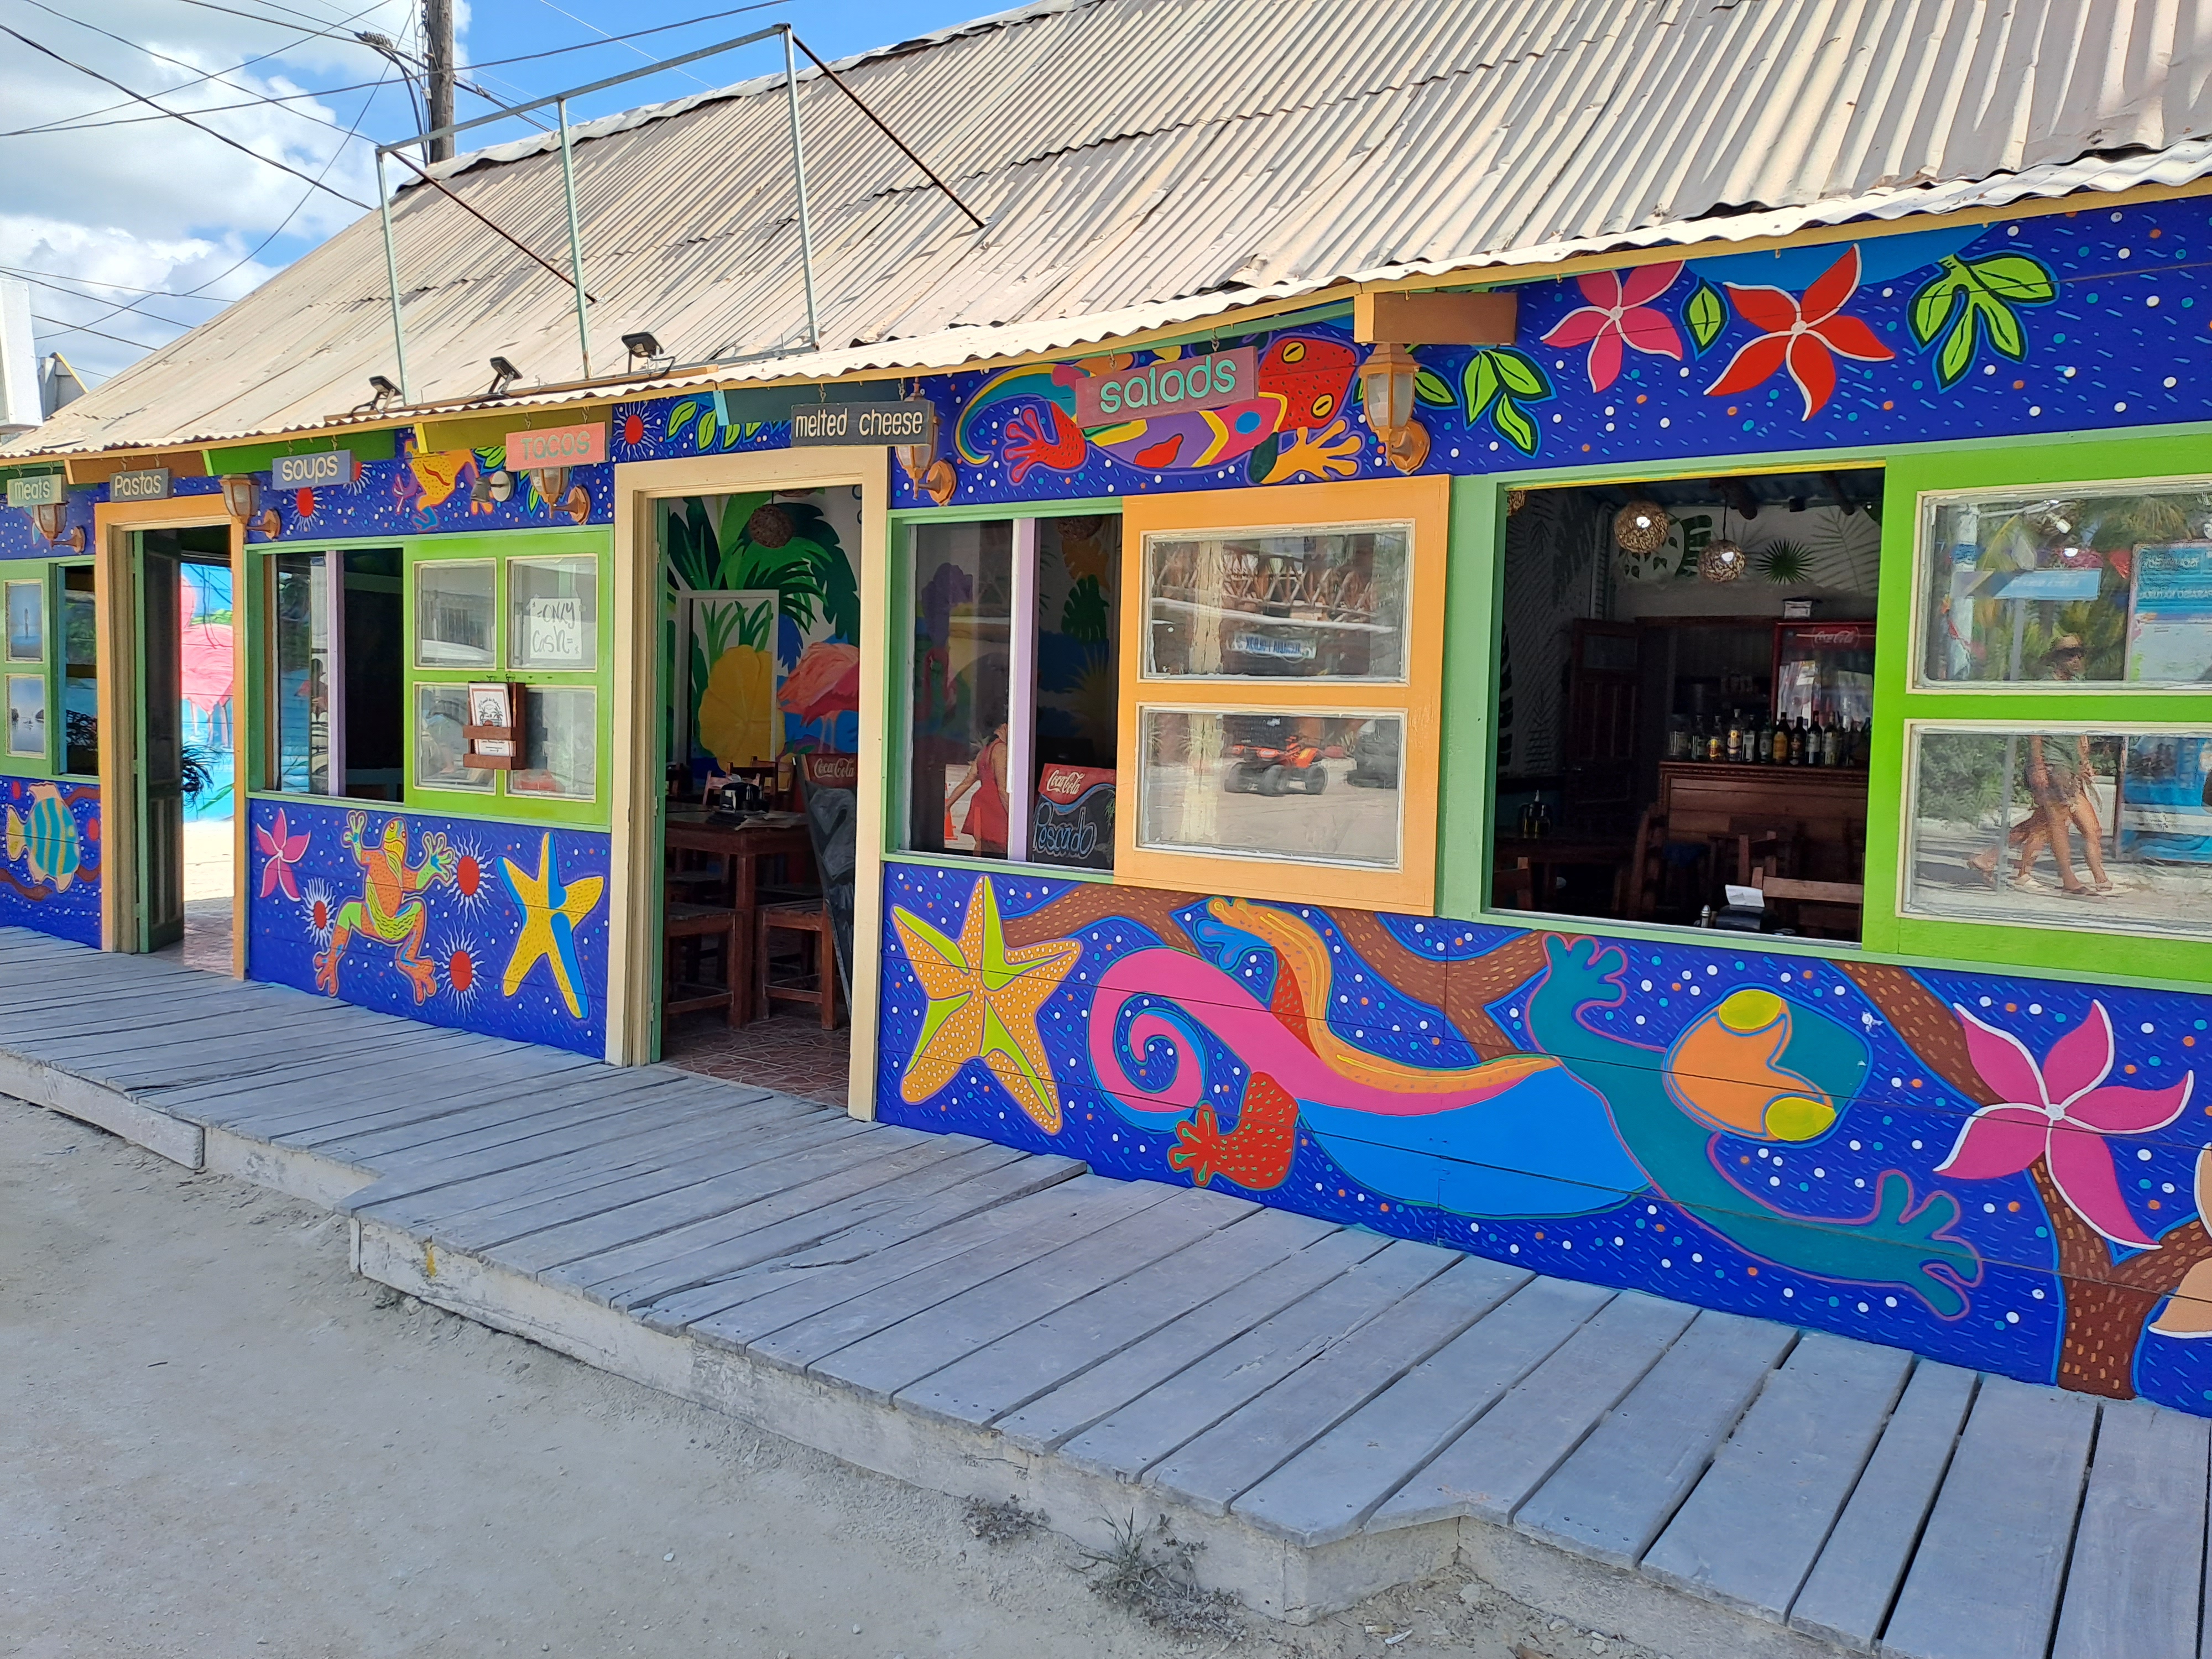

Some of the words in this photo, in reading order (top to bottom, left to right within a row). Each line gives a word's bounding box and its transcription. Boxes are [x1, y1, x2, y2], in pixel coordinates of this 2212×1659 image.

[1100, 355, 1237, 414] salads
[795, 407, 848, 438] melted
[858, 408, 924, 436] cheese
[114, 471, 162, 497] Pastas
[1032, 802, 1097, 858] Pescado
